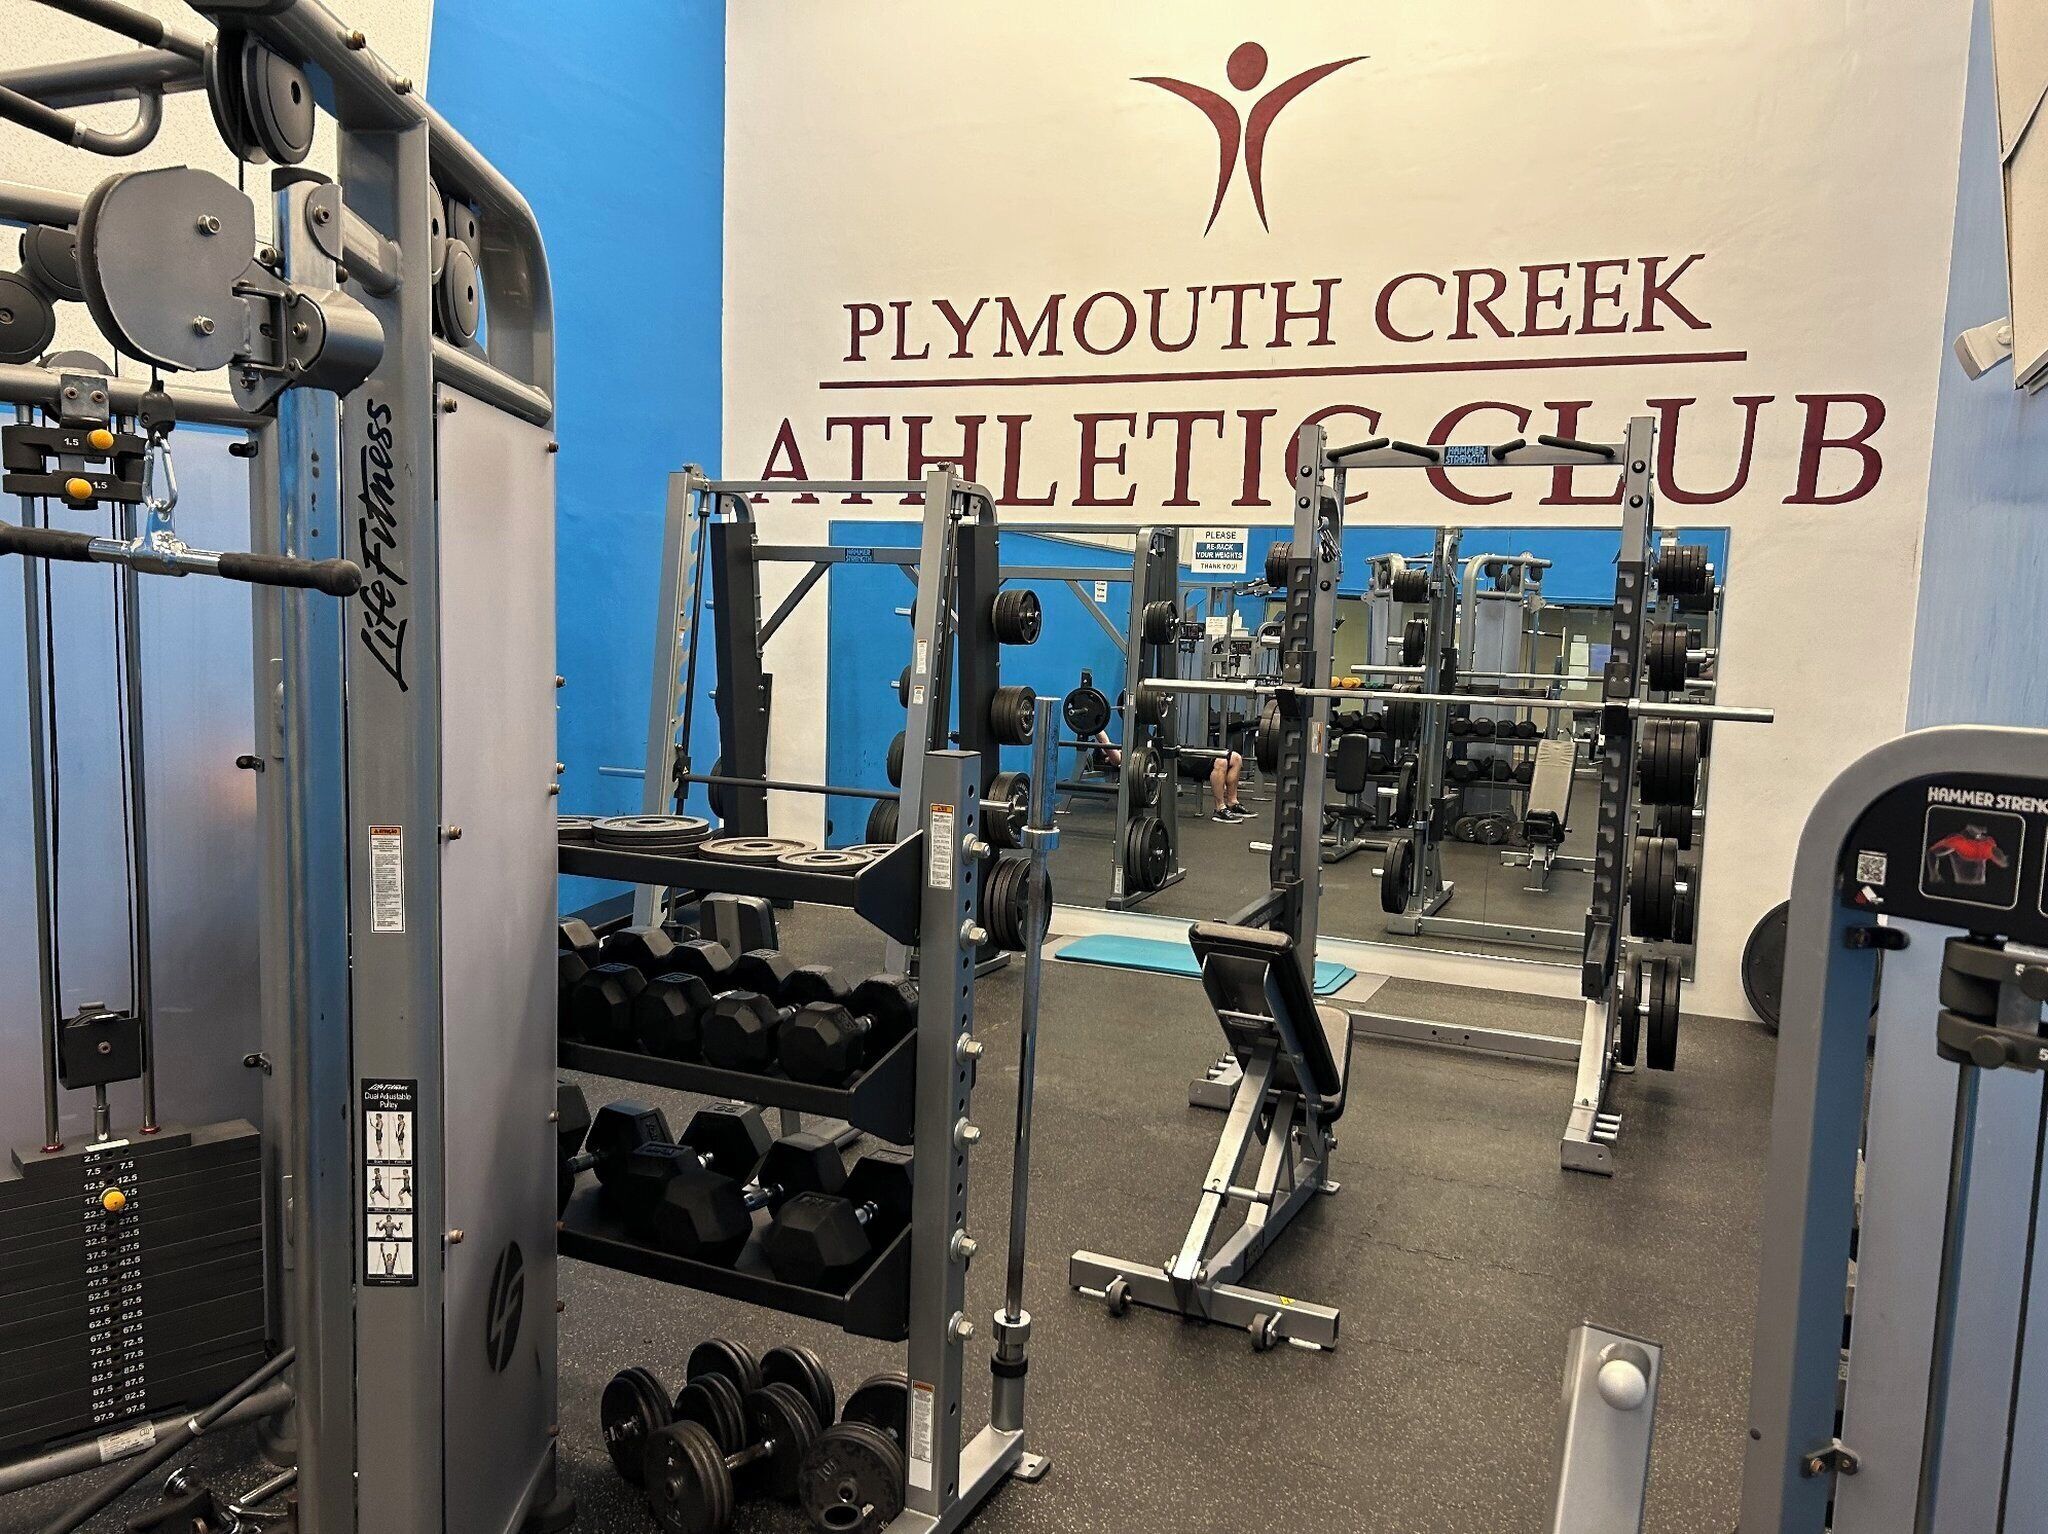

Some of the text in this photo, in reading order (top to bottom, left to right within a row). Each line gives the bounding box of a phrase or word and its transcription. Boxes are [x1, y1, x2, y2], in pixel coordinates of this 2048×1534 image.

[843, 253, 1711, 362] PLYMOUTH CREEK
[64, 437, 79, 446] 1.5
[750, 393, 1887, 507] ATHLETIC CLUB
[1448, 446, 1485, 455] HAMMER
[92, 481, 108, 489] 1.5
[1205, 531, 1237, 540] PLEASE
[1214, 551, 1243, 559] WEIGHTS
[1200, 562, 1221, 570] THANK
[1927, 786, 1995, 808] HAMMER
[84, 1154, 100, 1162] 2.5
[120, 1161, 134, 1170] 7.5
[86, 1168, 101, 1176] 7.5
[117, 1174, 138, 1184] 12.5
[83, 1181, 105, 1190] 12.5
[84, 1209, 106, 1219] 22.5
[119, 1215, 139, 1225] 27.5
[85, 1223, 106, 1233] 27.5
[119, 1228, 140, 1239] 32.5
[85, 1236, 107, 1247] 32.5
[120, 1242, 140, 1252] 37.5
[86, 1250, 107, 1260] 37.5
[120, 1256, 141, 1266] 42.5
[86, 1263, 108, 1274] 42.5
[121, 1270, 141, 1280] 47.5
[87, 1277, 108, 1287] 47.5
[121, 1283, 142, 1294] 52.5
[88, 1290, 110, 1301] 52.5
[122, 1296, 142, 1307] 57.5
[89, 1304, 110, 1315] 57.5
[122, 1310, 143, 1320] 62.5
[89, 1317, 111, 1329] 62.5
[123, 1323, 143, 1334] 67.5
[90, 1331, 111, 1342] 67.5
[122, 1336, 144, 1348] 72.5
[90, 1345, 112, 1355] 72.5
[124, 1350, 144, 1360] 77.5
[91, 1358, 112, 1369] 77.5
[123, 1363, 145, 1374] 82.5
[91, 1371, 113, 1383] 82.5
[125, 1376, 145, 1387] 87.5
[93, 1385, 113, 1396] 87.5
[124, 1389, 146, 1401] 92.5
[92, 1398, 114, 1410] 92.5
[126, 1403, 146, 1414] 97.5
[94, 1412, 114, 1422] 97.5
